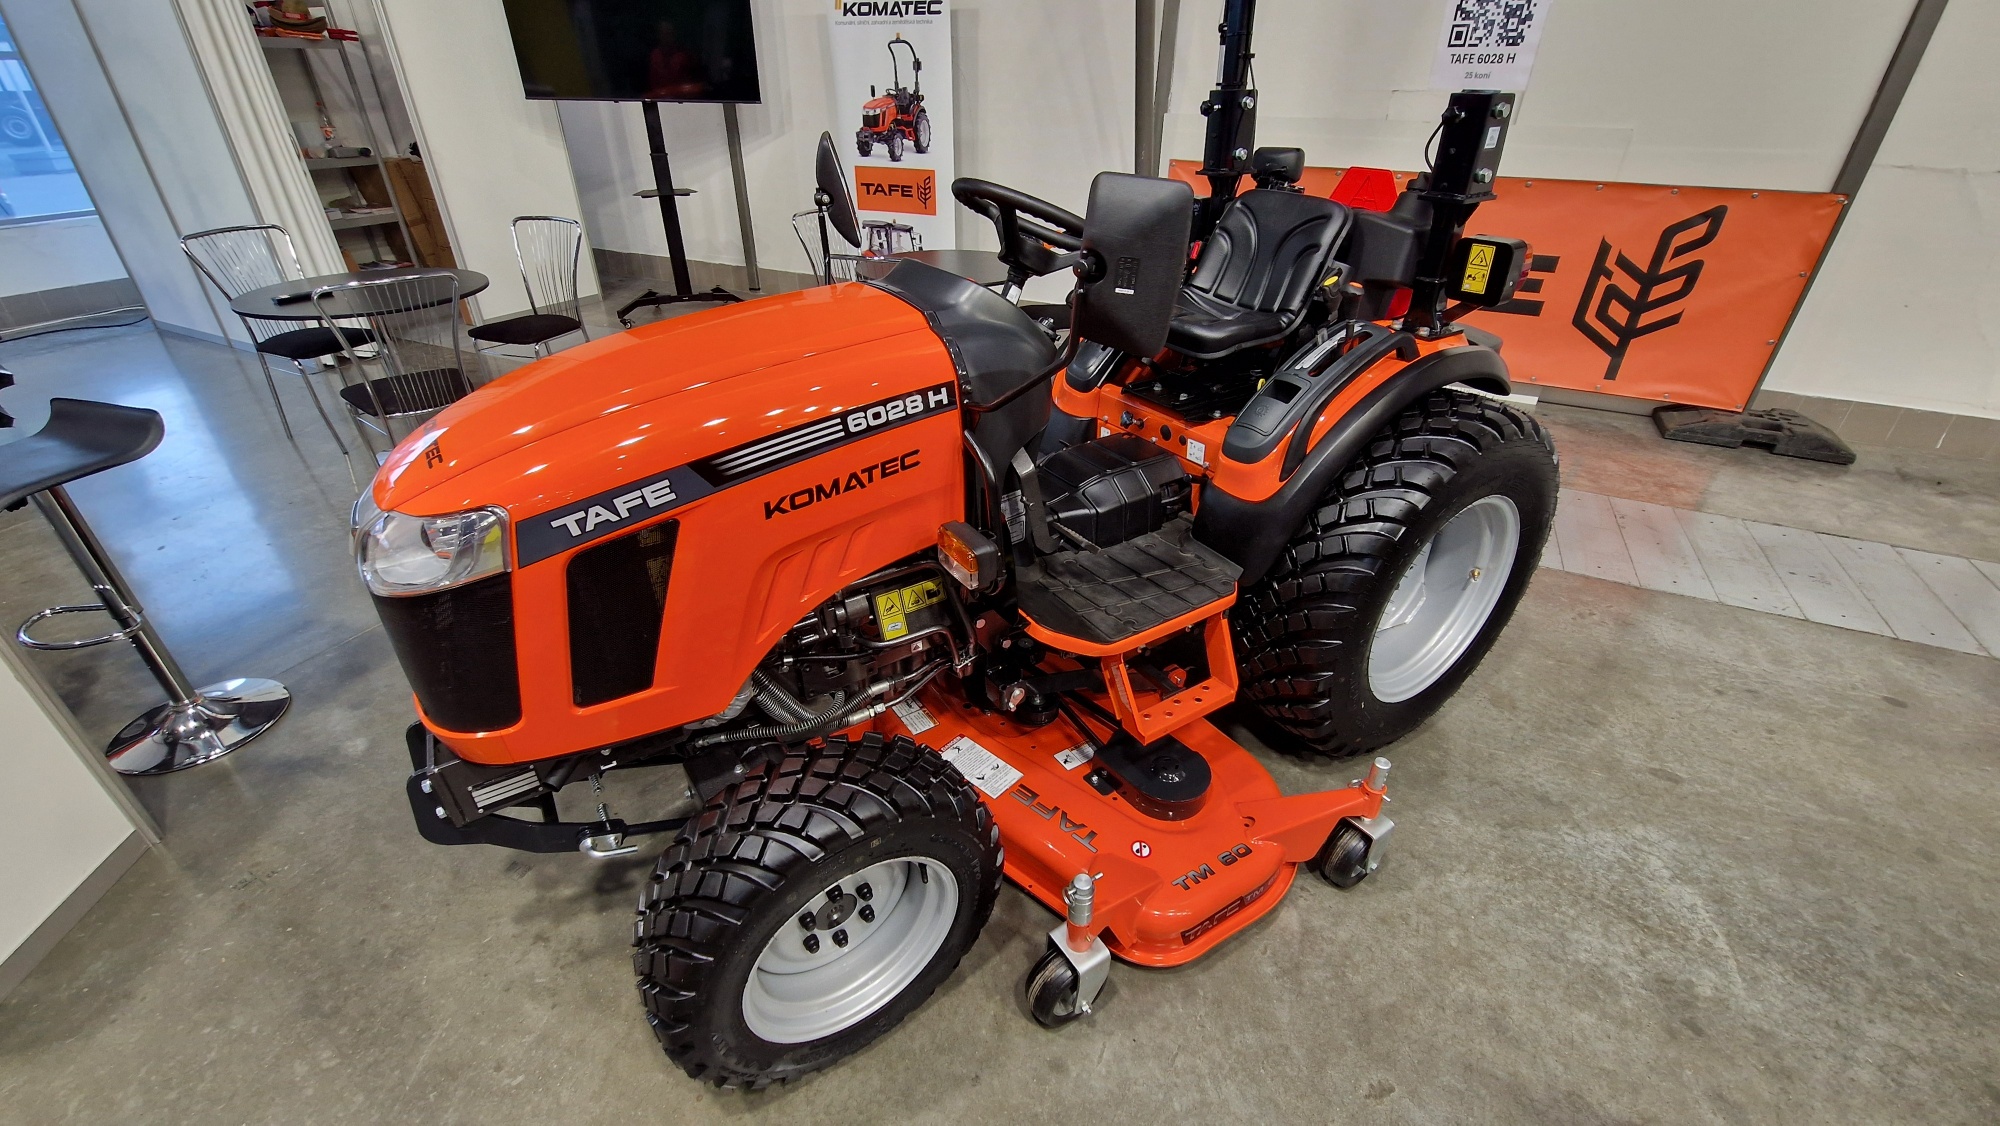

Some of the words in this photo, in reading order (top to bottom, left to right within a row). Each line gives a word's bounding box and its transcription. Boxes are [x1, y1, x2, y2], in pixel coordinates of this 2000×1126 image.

[842, 0, 944, 18] KOMATEC
[1450, 53, 1476, 64] TAFE
[1477, 53, 1504, 64] 6028
[1506, 52, 1517, 64] H
[1464, 71, 1474, 79] 25
[860, 182, 914, 198] TAFE
[847, 394, 924, 433] 6028
[927, 387, 949, 408] H
[550, 479, 677, 537] TAFE
[763, 449, 922, 521] KOMATEC
[1009, 783, 1099, 854] TAFE
[1171, 863, 1216, 891] TM
[1217, 843, 1253, 867] 60
